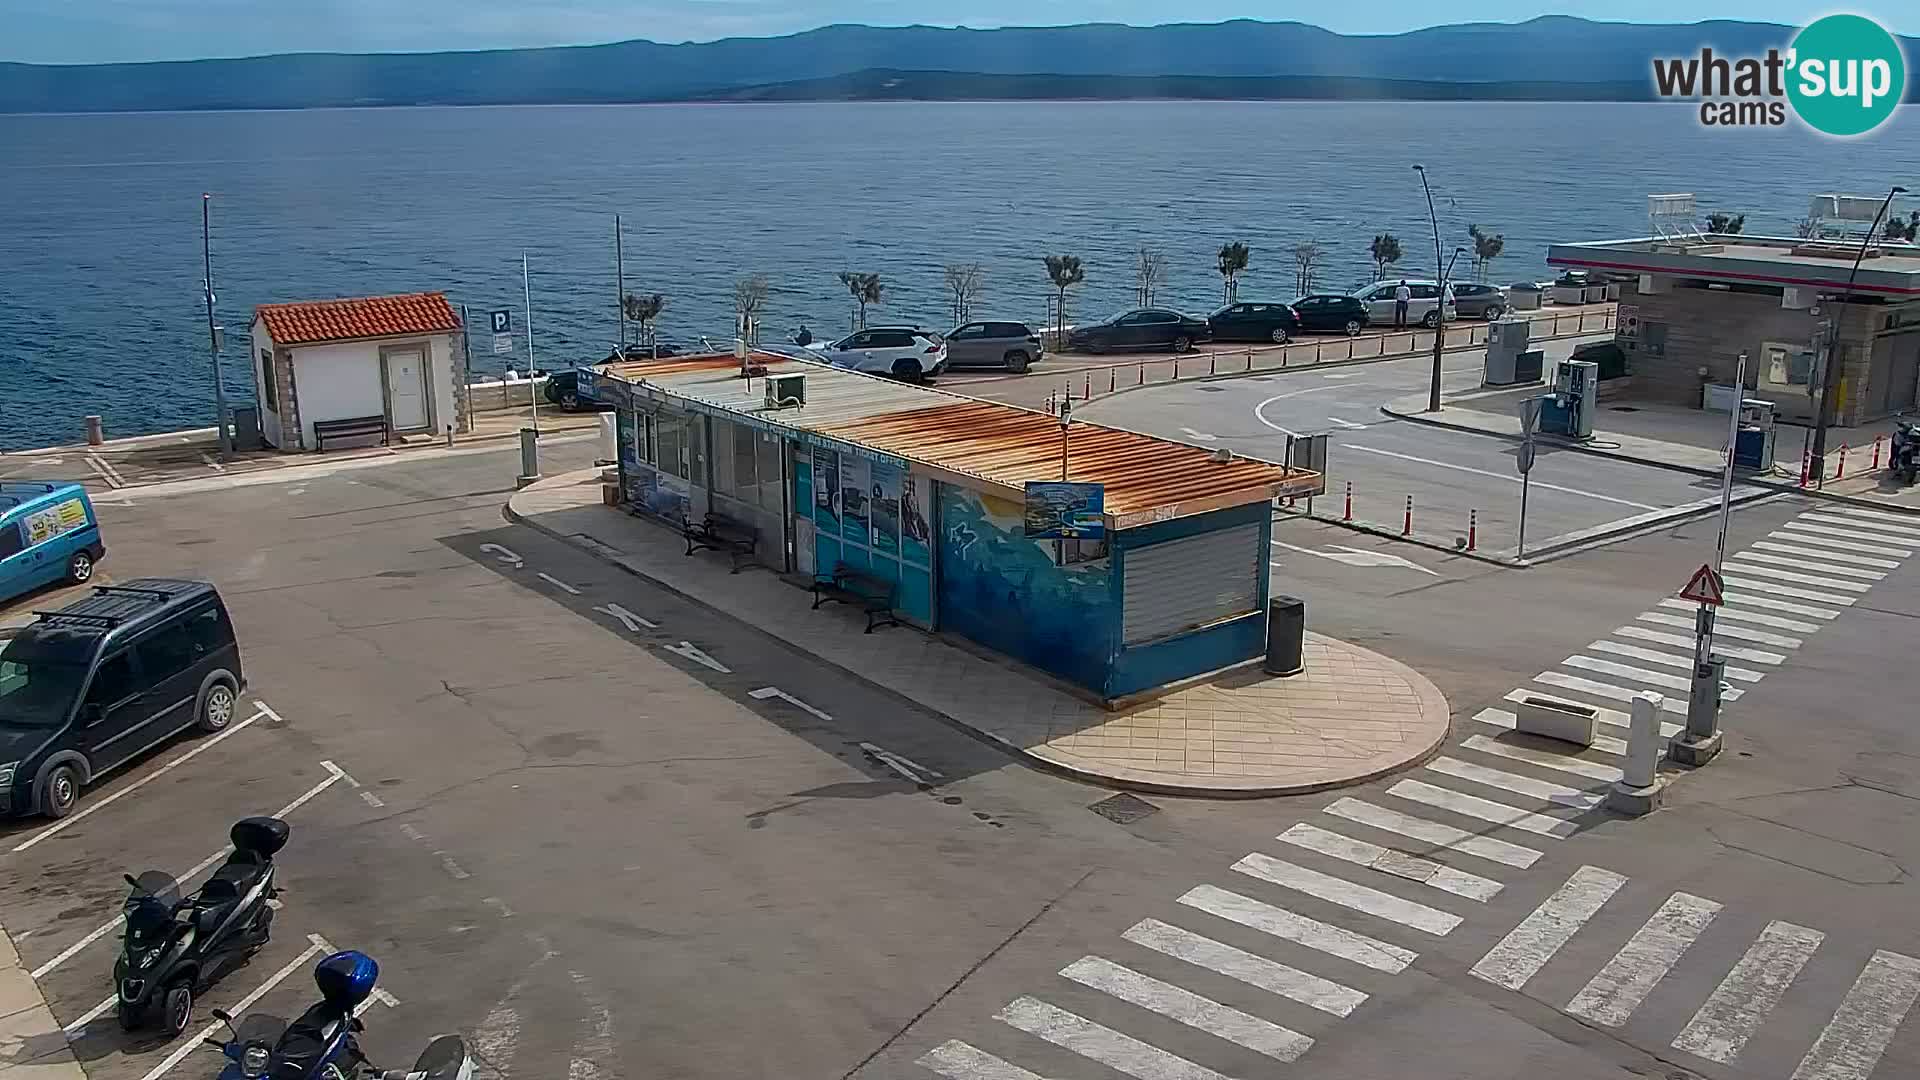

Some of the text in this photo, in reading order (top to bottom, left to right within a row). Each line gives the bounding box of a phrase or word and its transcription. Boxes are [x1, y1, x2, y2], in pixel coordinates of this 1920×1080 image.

[495, 313, 506, 330] P
[823, 437, 853, 453] STATION
[855, 447, 878, 461] TICKET
[880, 454, 906, 469] OFFICE
